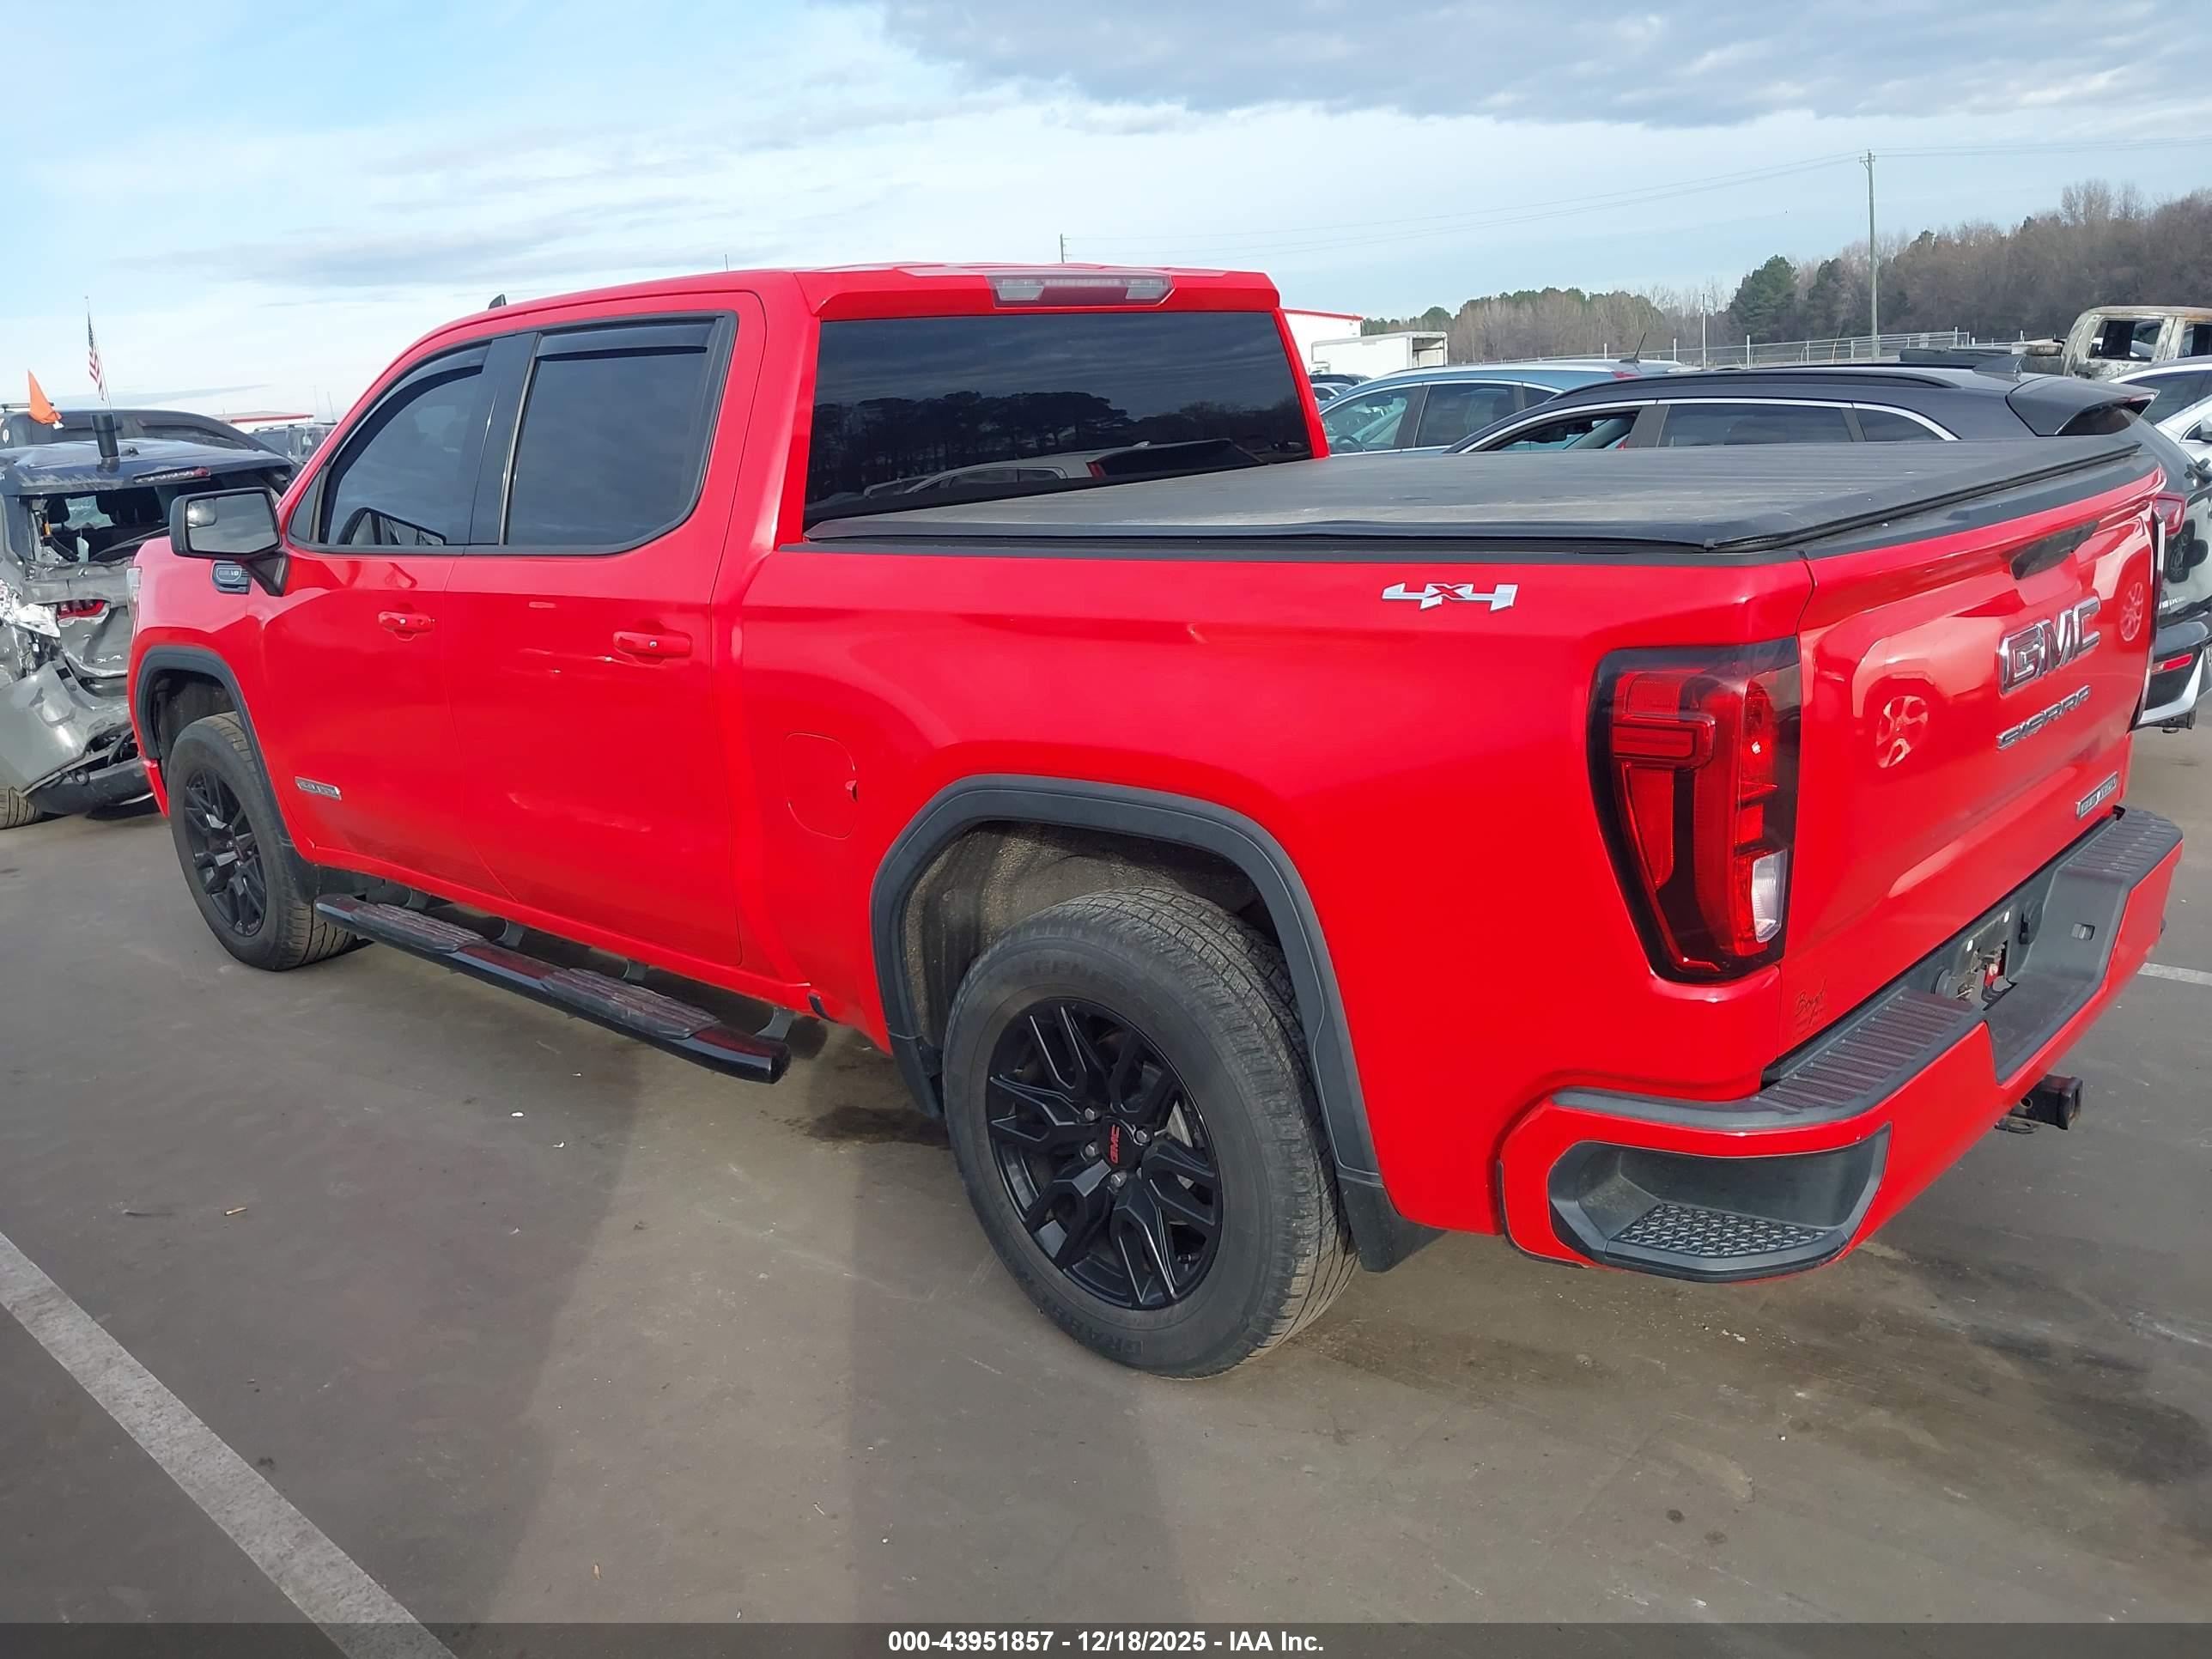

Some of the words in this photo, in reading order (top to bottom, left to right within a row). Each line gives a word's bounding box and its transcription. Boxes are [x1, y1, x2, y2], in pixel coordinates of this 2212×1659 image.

[1382, 582, 1518, 611] 4X4
[1997, 596, 2100, 698] GMC
[1996, 685, 2091, 750] SIERRA
[1110, 1124, 1120, 1164] GMC
